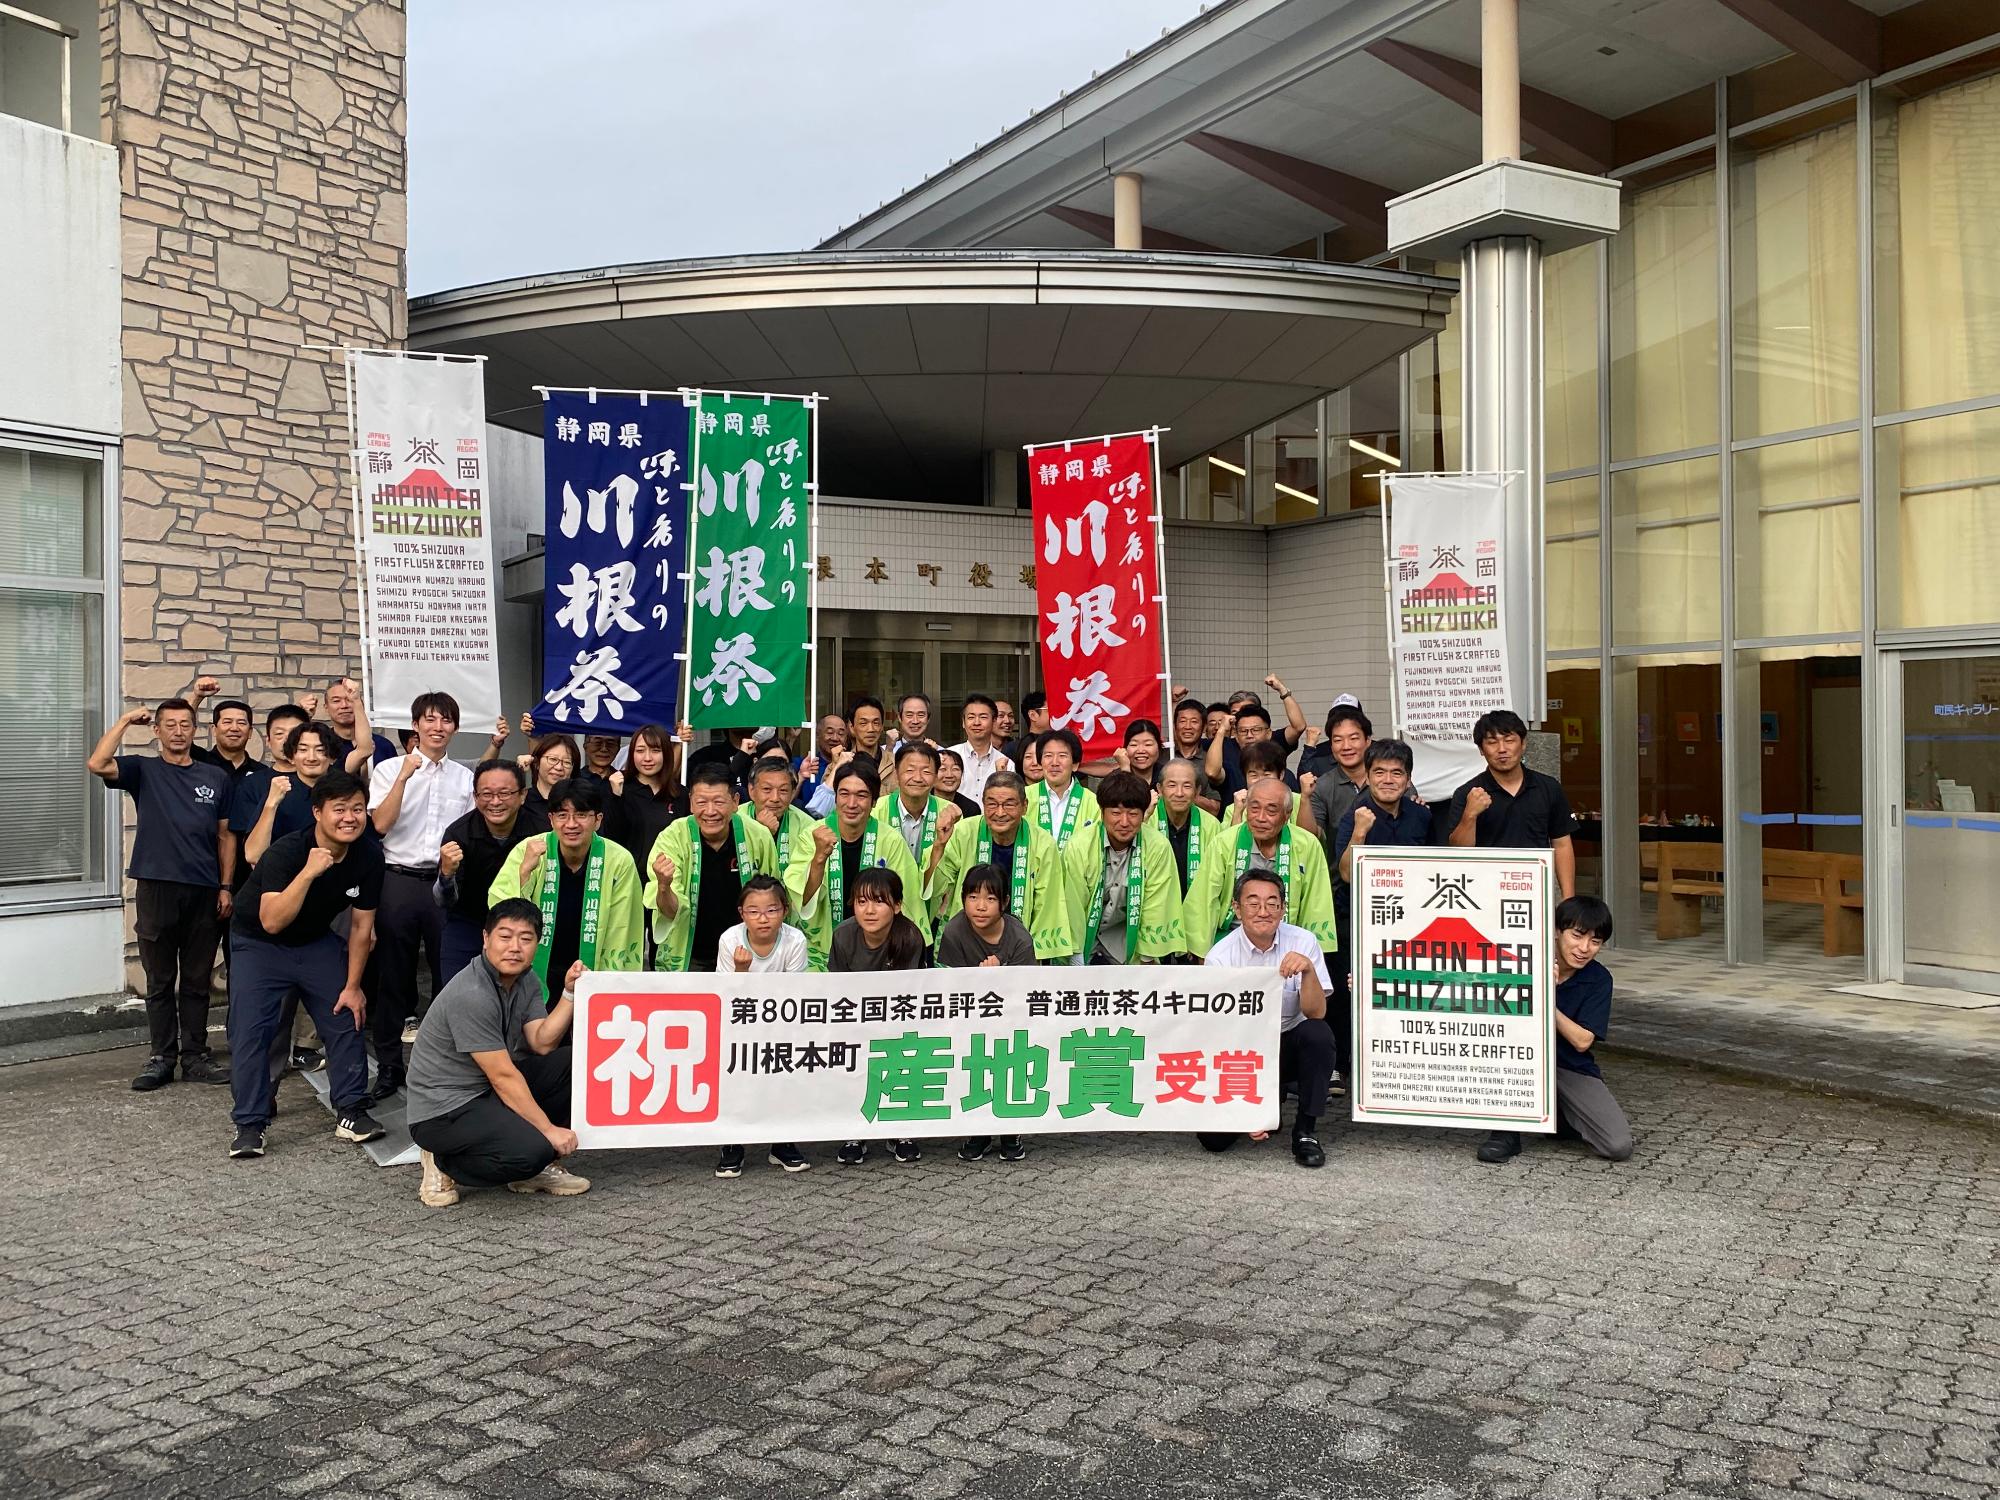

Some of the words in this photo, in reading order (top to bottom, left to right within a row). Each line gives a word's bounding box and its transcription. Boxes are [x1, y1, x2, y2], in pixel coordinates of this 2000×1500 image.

[555, 415, 642, 449] 静岡県
[696, 412, 771, 437] 静岡県
[1038, 454, 1112, 486] 静岡県
[371, 484, 438, 508] JAPAN
[444, 487, 481, 510] TEA
[372, 512, 482, 538] SHIZUOKA
[393, 543, 419, 554] 100%
[422, 544, 465, 555] SHIZUOKA
[374, 557, 402, 568] FIRST
[404, 557, 435, 569] FLUSH
[444, 559, 484, 571] CRAFTED
[376, 574, 421, 583] FUJINOMIYA
[425, 576, 454, 585] NUMAZU
[458, 577, 485, 585] HARUNO
[693, 458, 777, 707] 川根茶
[376, 587, 407, 596] SHIMIZU
[412, 588, 448, 597] RYOGOCHI
[452, 589, 486, 598] SHIZUOKA
[545, 474, 647, 724] 川根茶
[1401, 587, 1458, 608] JAPAN
[1463, 584, 1497, 606] TEA
[377, 601, 424, 610] HAMAMATSU
[428, 602, 461, 611] HONYAMA
[465, 603, 487, 611] IWATA
[377, 613, 411, 622] SHIMADA
[415, 614, 446, 623] FUJIEDA
[450, 615, 487, 624] KAKEGAWA
[1043, 500, 1131, 743] 川根茶
[1401, 609, 1498, 633] SHIZUOKA
[378, 627, 426, 635] MAKINOHARA
[430, 627, 467, 636] OMAEZAKI
[471, 628, 488, 636] MORI
[1418, 639, 1440, 649] 100%
[1442, 637, 1482, 648] SHIZUOKA
[378, 639, 411, 647] FUKUROI
[414, 640, 449, 648] GOTEMBA
[453, 640, 489, 649] KIKUGAWA
[1403, 652, 1426, 662] FIRST
[1428, 651, 1454, 661] FLUSH
[1463, 649, 1500, 660] CRAFTED
[380, 651, 409, 660] KANAYA
[411, 652, 429, 661] FUJI
[431, 653, 459, 661] TENRYU
[461, 653, 490, 662] KAWANE
[862, 832, 876, 866] 静岡県
[1279, 843, 1290, 876] 静岡県
[588, 856, 603, 891] 静岡県
[1015, 846, 1027, 879] 静岡県
[1371, 868, 1403, 878] JAPAN'S
[1371, 878, 1403, 888] LEADING
[1500, 871, 1532, 881] TEA
[1500, 881, 1533, 891] REGION
[583, 898, 599, 943] 川根本町
[1372, 939, 1467, 973] JAPAN
[1477, 942, 1533, 975] TEA
[729, 991, 1005, 1025] 第80回全国茶品評会
[1025, 990, 1264, 1018] 普通煎茶4キロの部
[1372, 978, 1533, 1016] SHIZUOKA
[1400, 1020, 1436, 1035] 100%
[1439, 1021, 1505, 1038] SHIZUOKA
[593, 1004, 711, 1117] 祝
[1372, 1039, 1410, 1054] FIRST
[1413, 1041, 1456, 1058] FLUSH
[1472, 1044, 1534, 1061] CRAFTED
[726, 1040, 862, 1076] 川根本町
[861, 1027, 1147, 1125] 産地賞
[1155, 1049, 1264, 1106] 受賞
